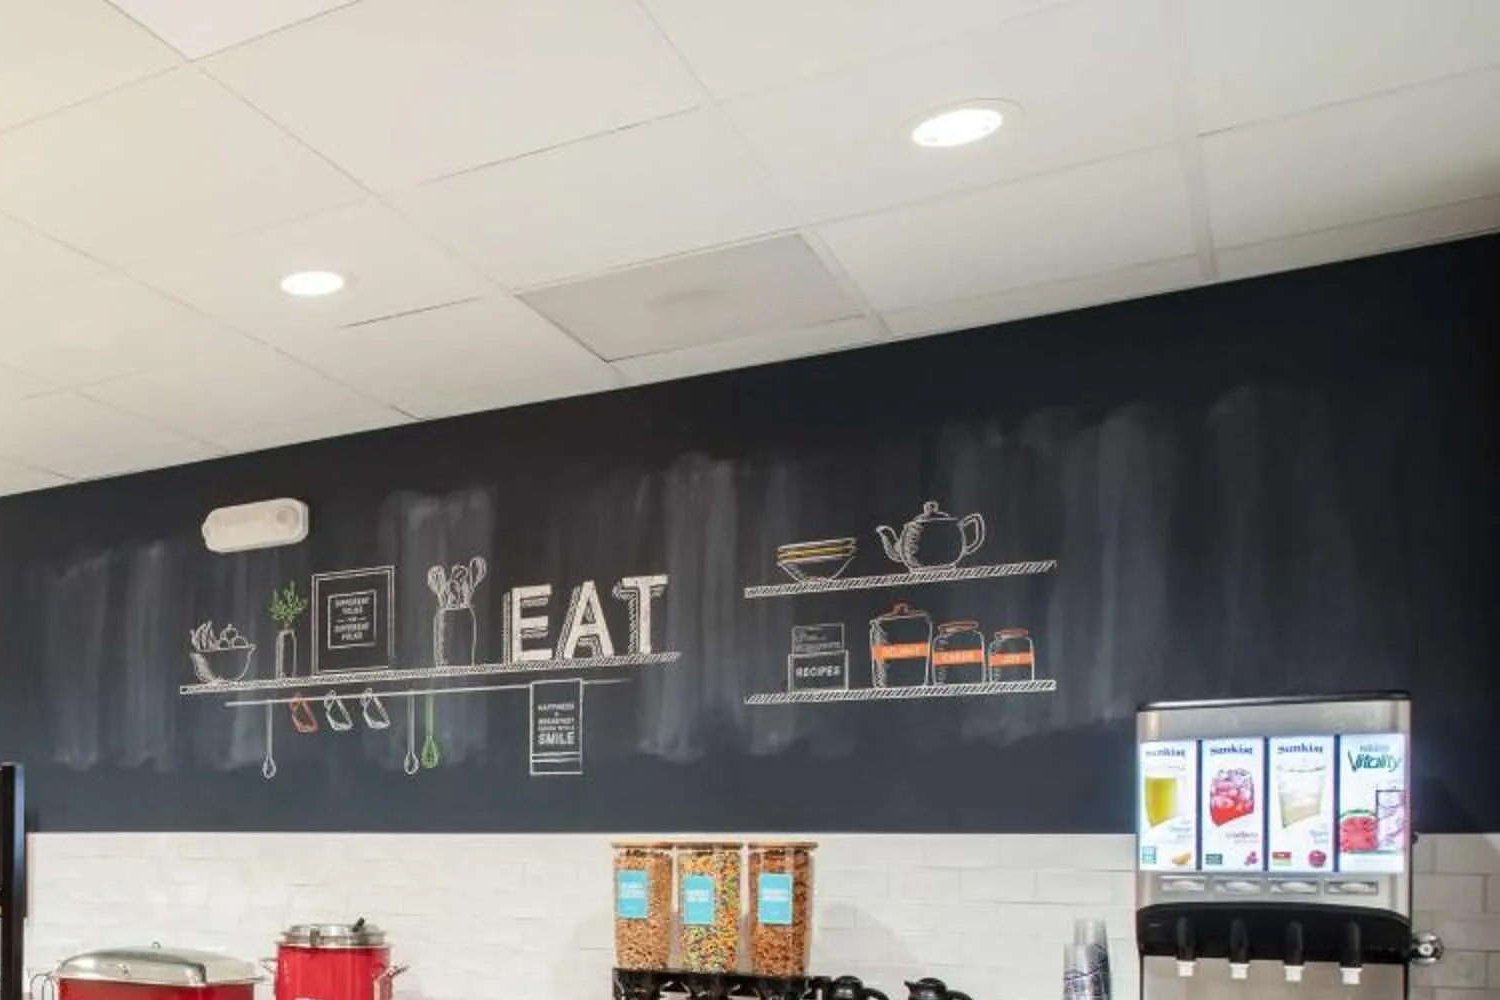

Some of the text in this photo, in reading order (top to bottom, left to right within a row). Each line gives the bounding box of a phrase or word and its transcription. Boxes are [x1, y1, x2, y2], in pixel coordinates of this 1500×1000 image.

[503, 575, 669, 662] EAT
[795, 665, 841, 678] RECIPES
[538, 732, 575, 745] SMILE
